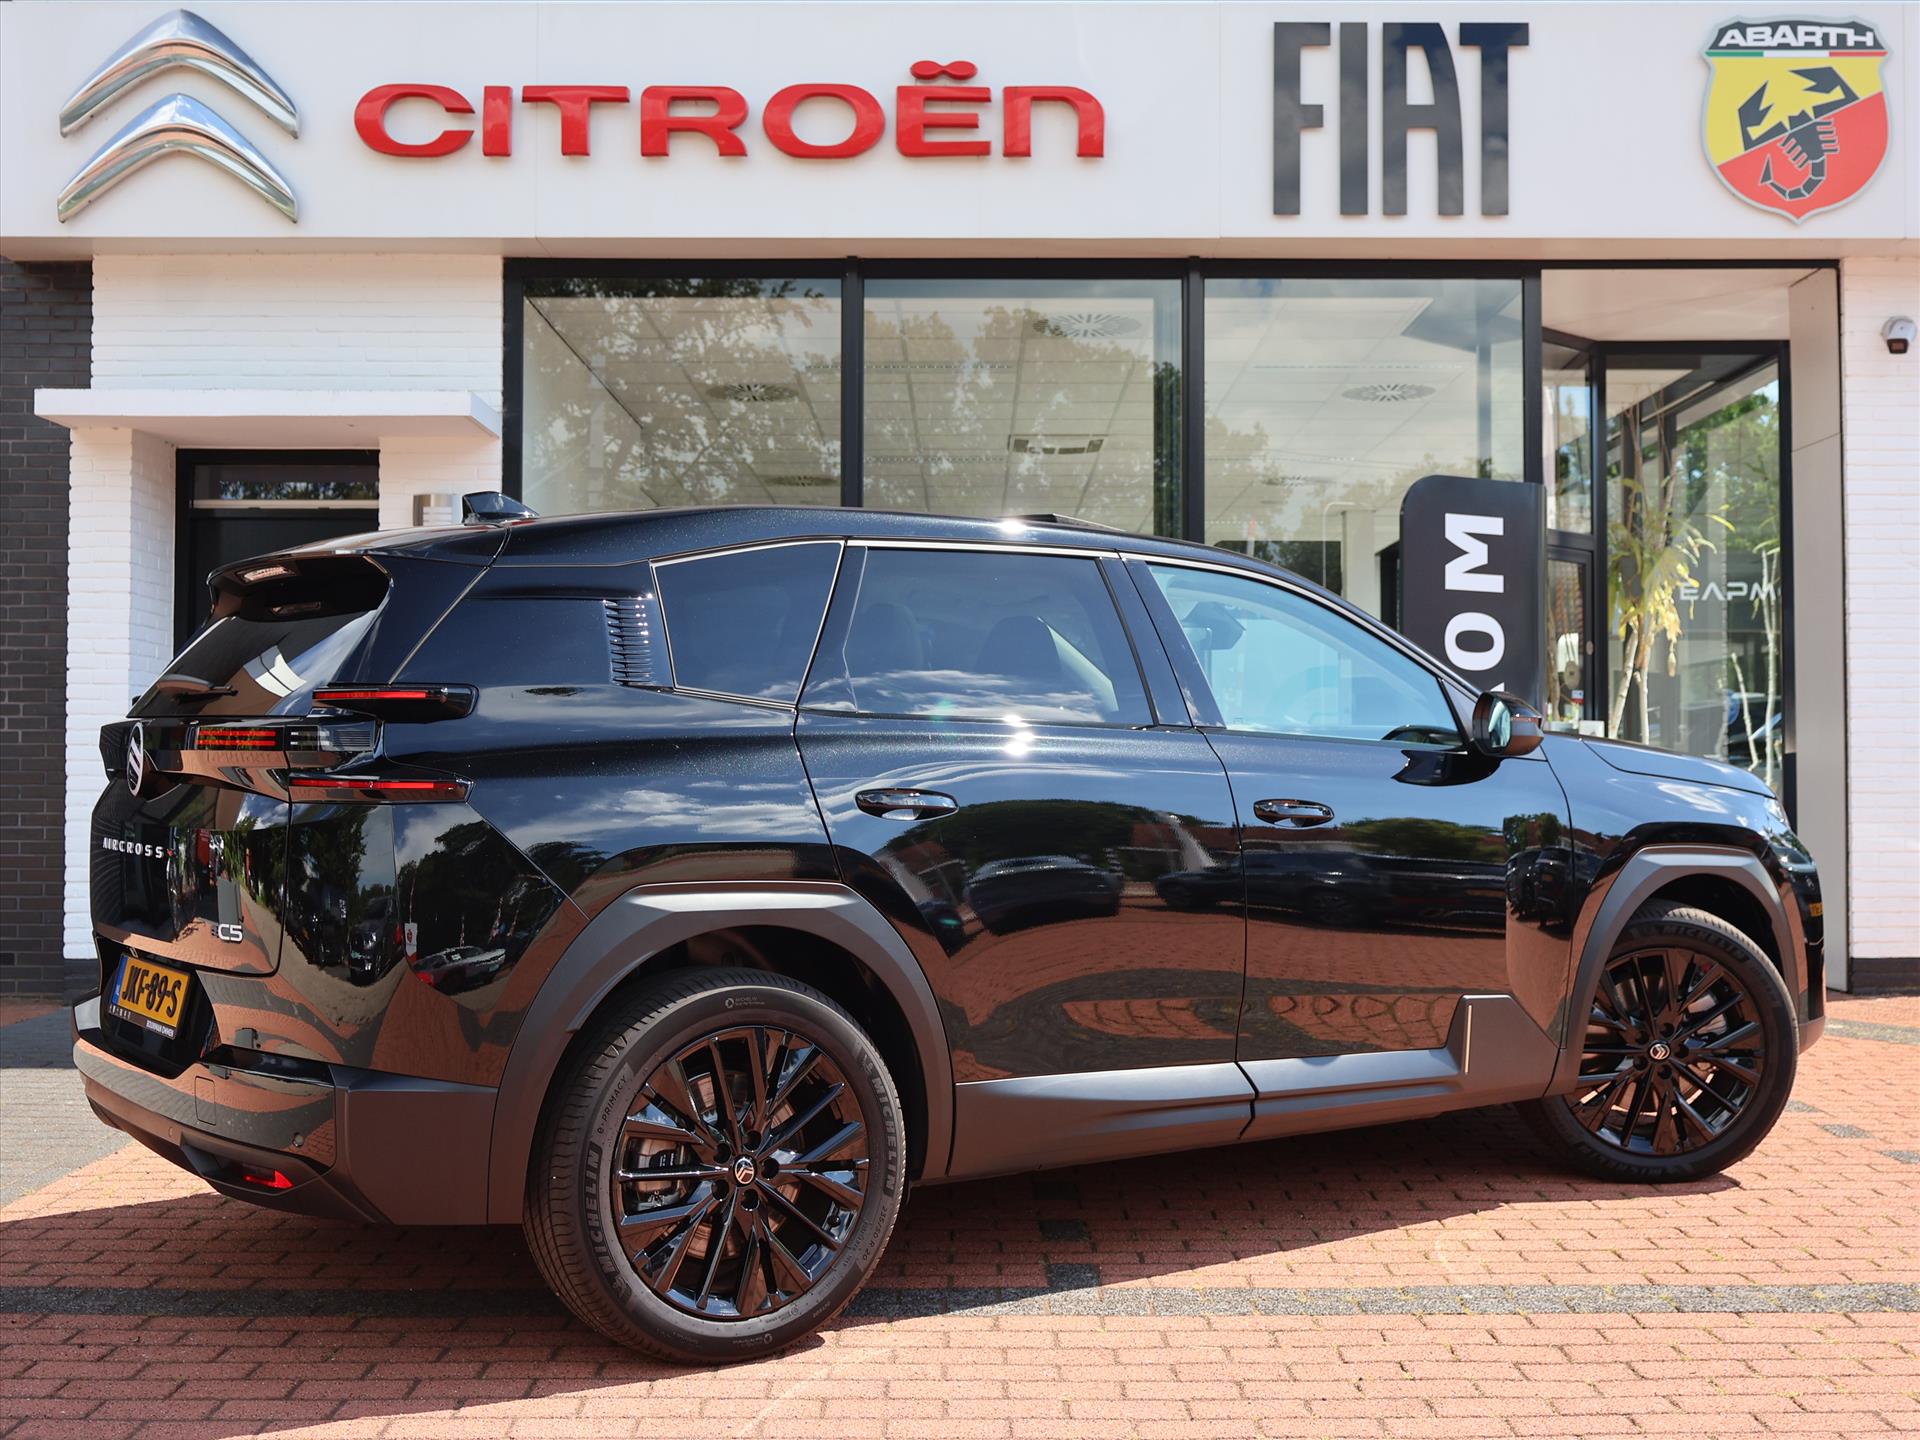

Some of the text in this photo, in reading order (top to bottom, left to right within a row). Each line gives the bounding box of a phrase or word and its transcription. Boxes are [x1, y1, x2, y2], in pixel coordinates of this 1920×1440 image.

[1718, 24, 1875, 47] ABARTH
[354, 60, 1106, 159] CITROËN
[1273, 22, 1529, 216] FIAT
[1444, 512, 1505, 691] OM
[102, 836, 164, 859] AIRCROSS
[217, 923, 243, 942] C5
[872, 1077, 898, 1191] MICHELIN
[585, 1150, 616, 1273] MICHELIN
